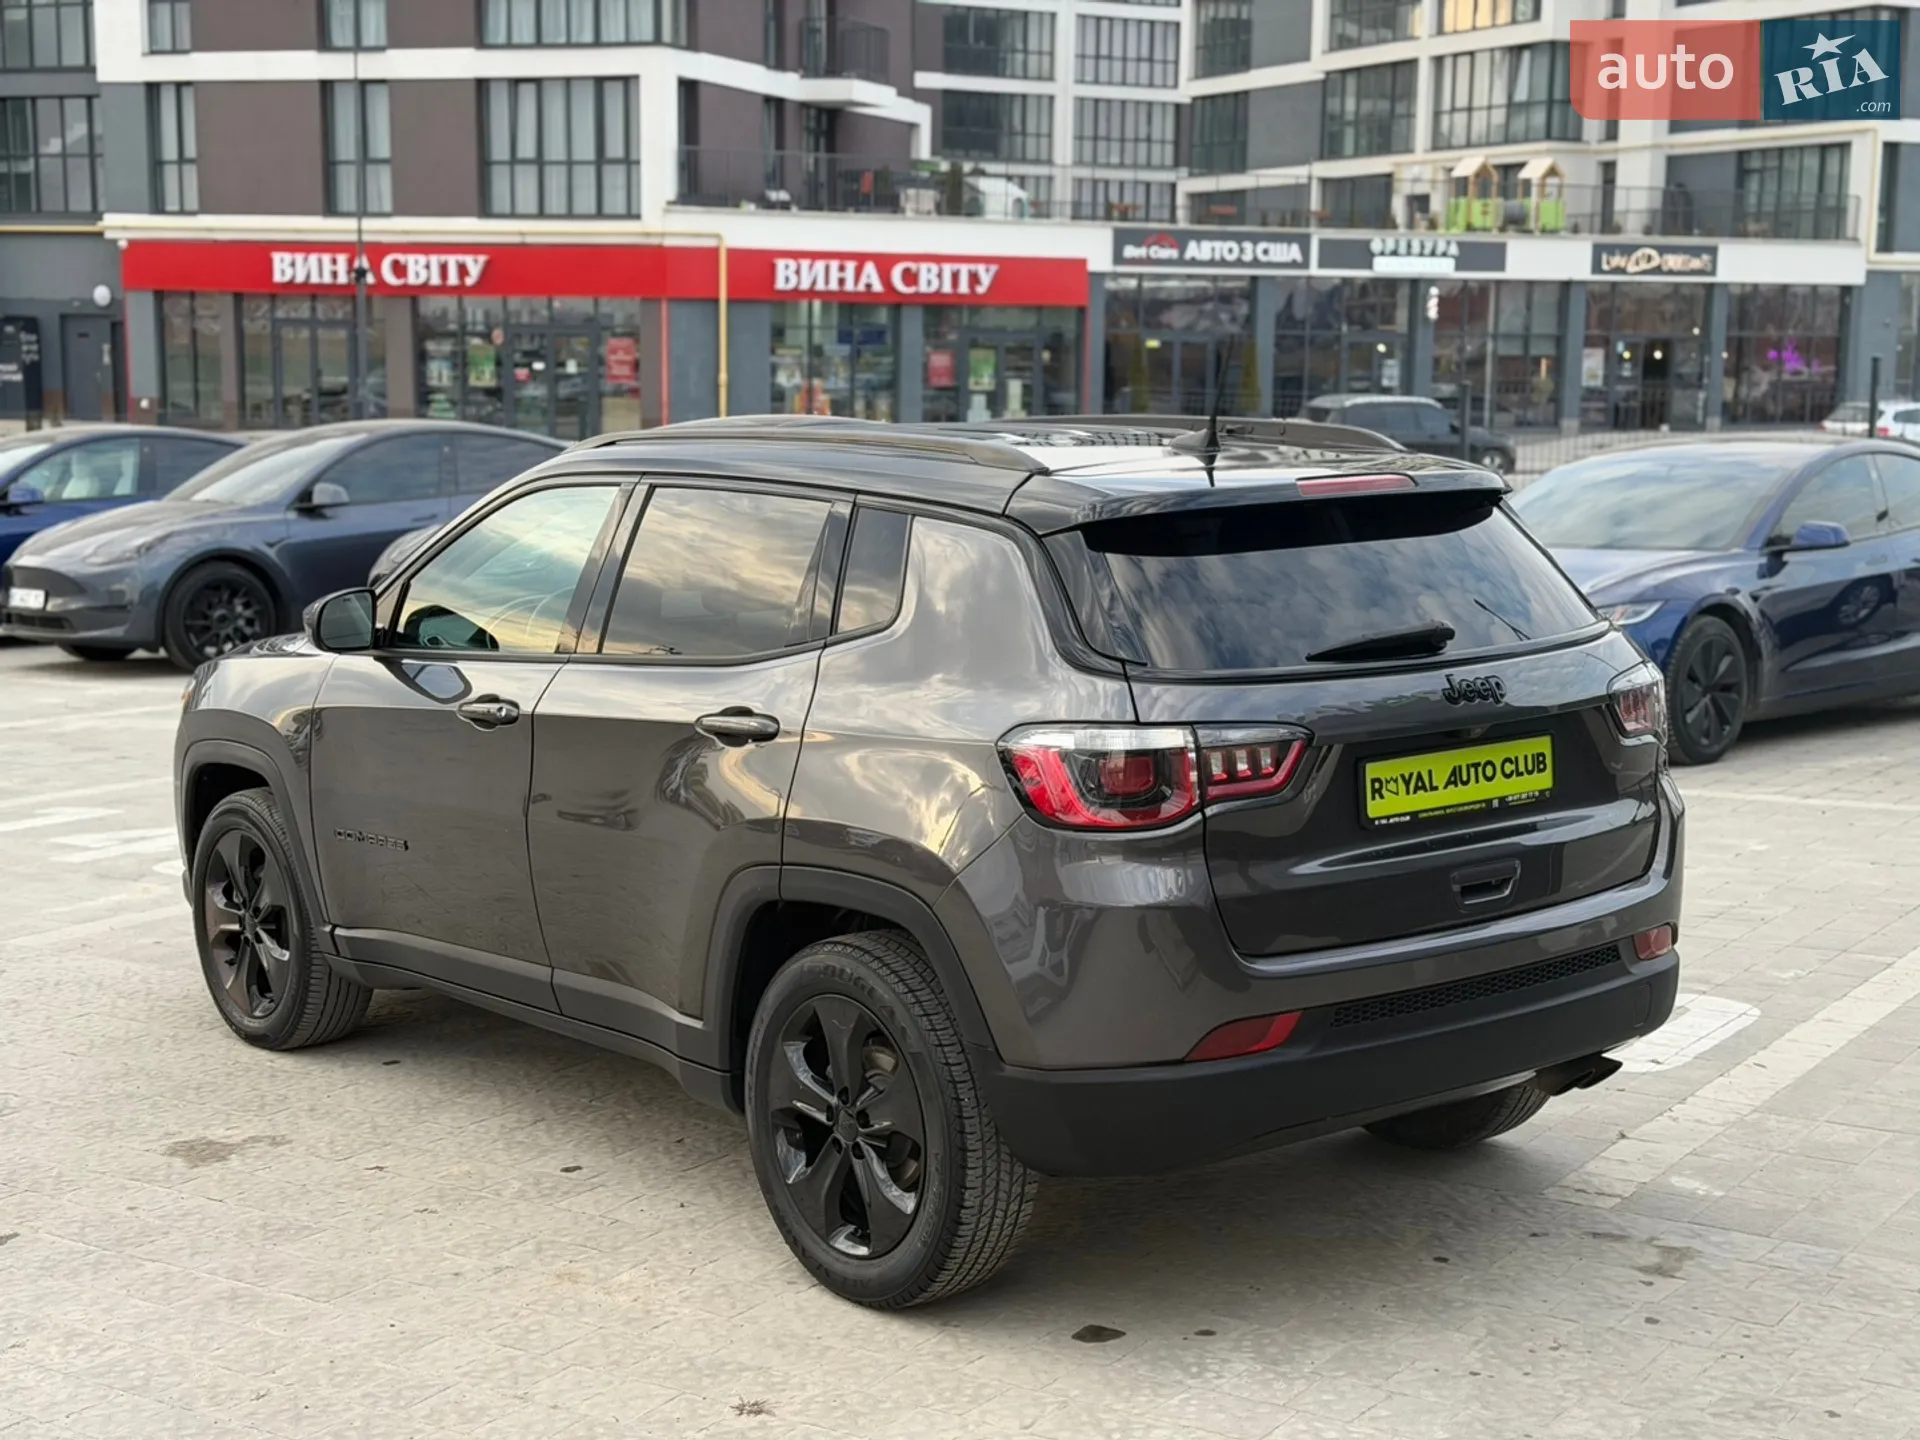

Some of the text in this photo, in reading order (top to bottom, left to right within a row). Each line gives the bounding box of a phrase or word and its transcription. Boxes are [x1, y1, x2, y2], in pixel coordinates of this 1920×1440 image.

[271, 251, 490, 287] ВИНА СВІТУ
[1184, 240, 1240, 262] АВТО
[1255, 241, 1303, 263] США
[773, 257, 1000, 295] ВИНА СВІТУ
[1441, 673, 1508, 707] Jeep
[1443, 759, 1497, 790] AUTO
[1500, 751, 1548, 780] CLUB
